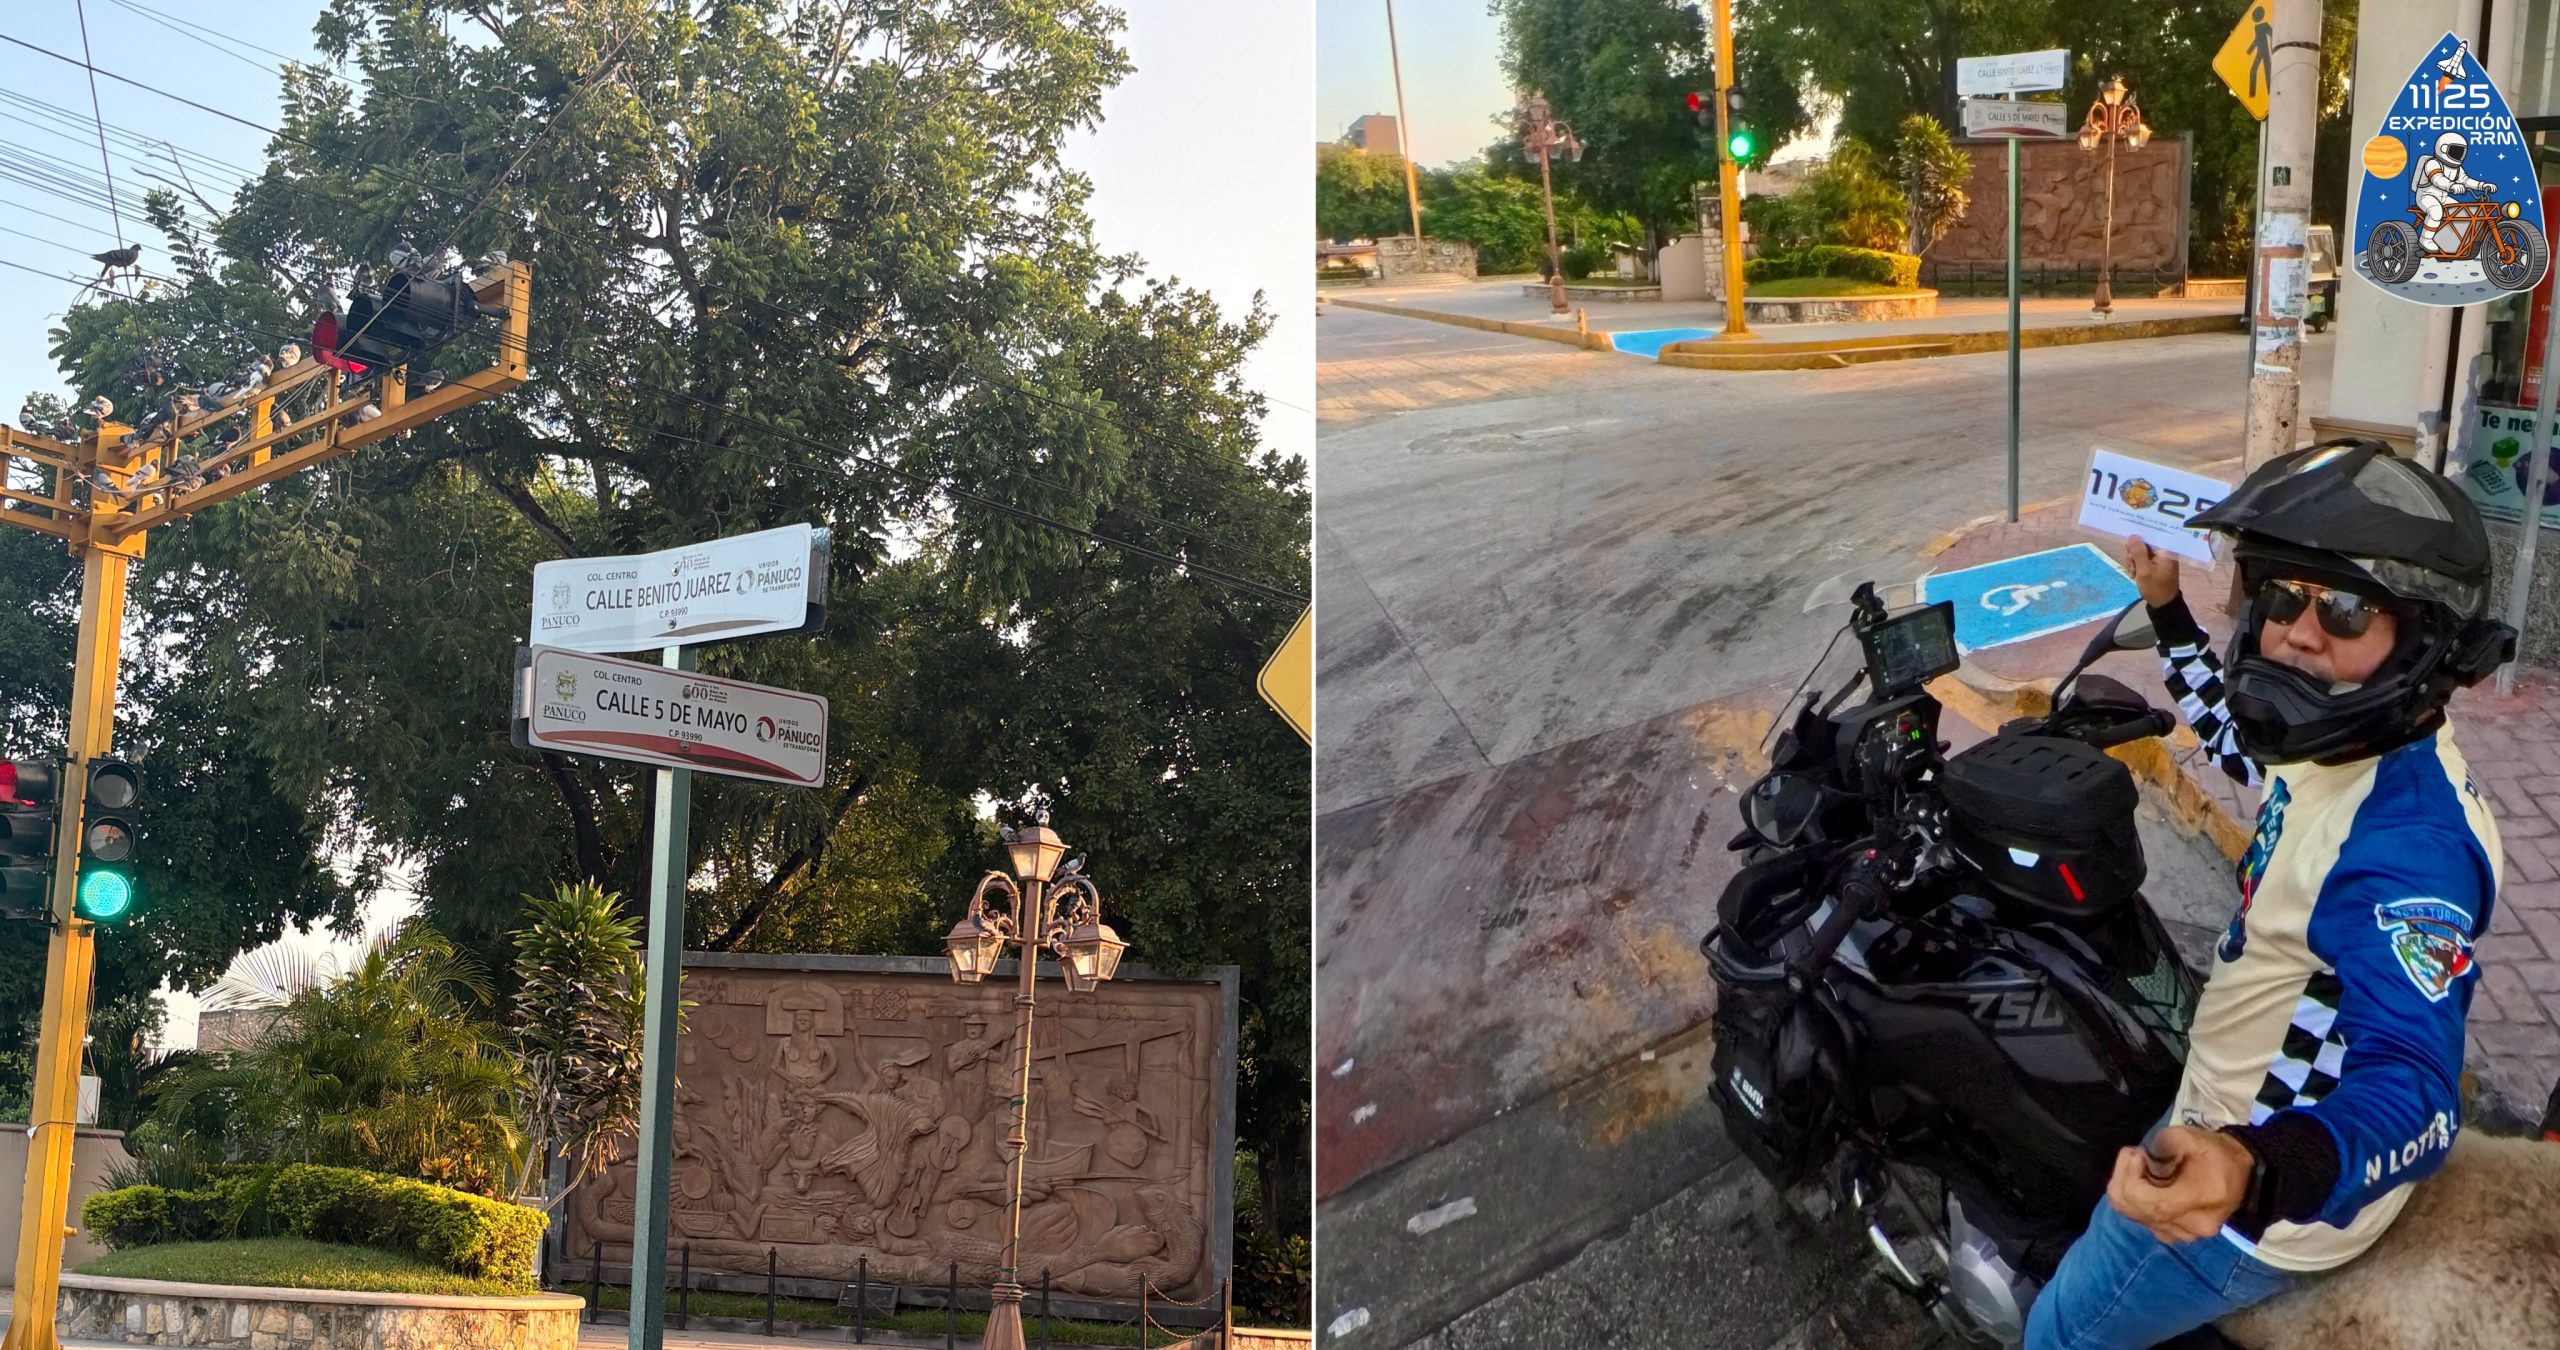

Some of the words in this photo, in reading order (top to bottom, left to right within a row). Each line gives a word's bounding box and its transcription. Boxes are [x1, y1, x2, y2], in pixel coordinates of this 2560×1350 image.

[1988, 111, 2006, 121] CALLE
[2012, 112, 2021, 121] DE
[2480, 410, 2500, 429] Te
[2092, 468, 2118, 500] 11
[606, 571, 638, 581] CENTRO
[757, 566, 802, 587] PÁNUCO
[586, 589, 633, 610] CALLE
[637, 581, 682, 608] BENITO
[684, 571, 732, 600] JUAREZ
[769, 582, 801, 593] TRANSFORMA
[659, 610, 670, 619] C.P.
[670, 606, 689, 617] 93990
[541, 614, 581, 628] PANUCO
[612, 673, 642, 686] CENTRO
[543, 704, 587, 721] PANUCO
[596, 689, 649, 718] CALLE
[655, 699, 664, 720] 5
[669, 702, 692, 725] DE
[697, 706, 748, 734] MAYO
[668, 729, 680, 738] C.P.
[681, 731, 703, 742] 93990
[777, 725, 821, 747] PÁNUCO
[2390, 907, 2424, 918] MOTO
[1742, 1078, 1764, 1109] BMW
